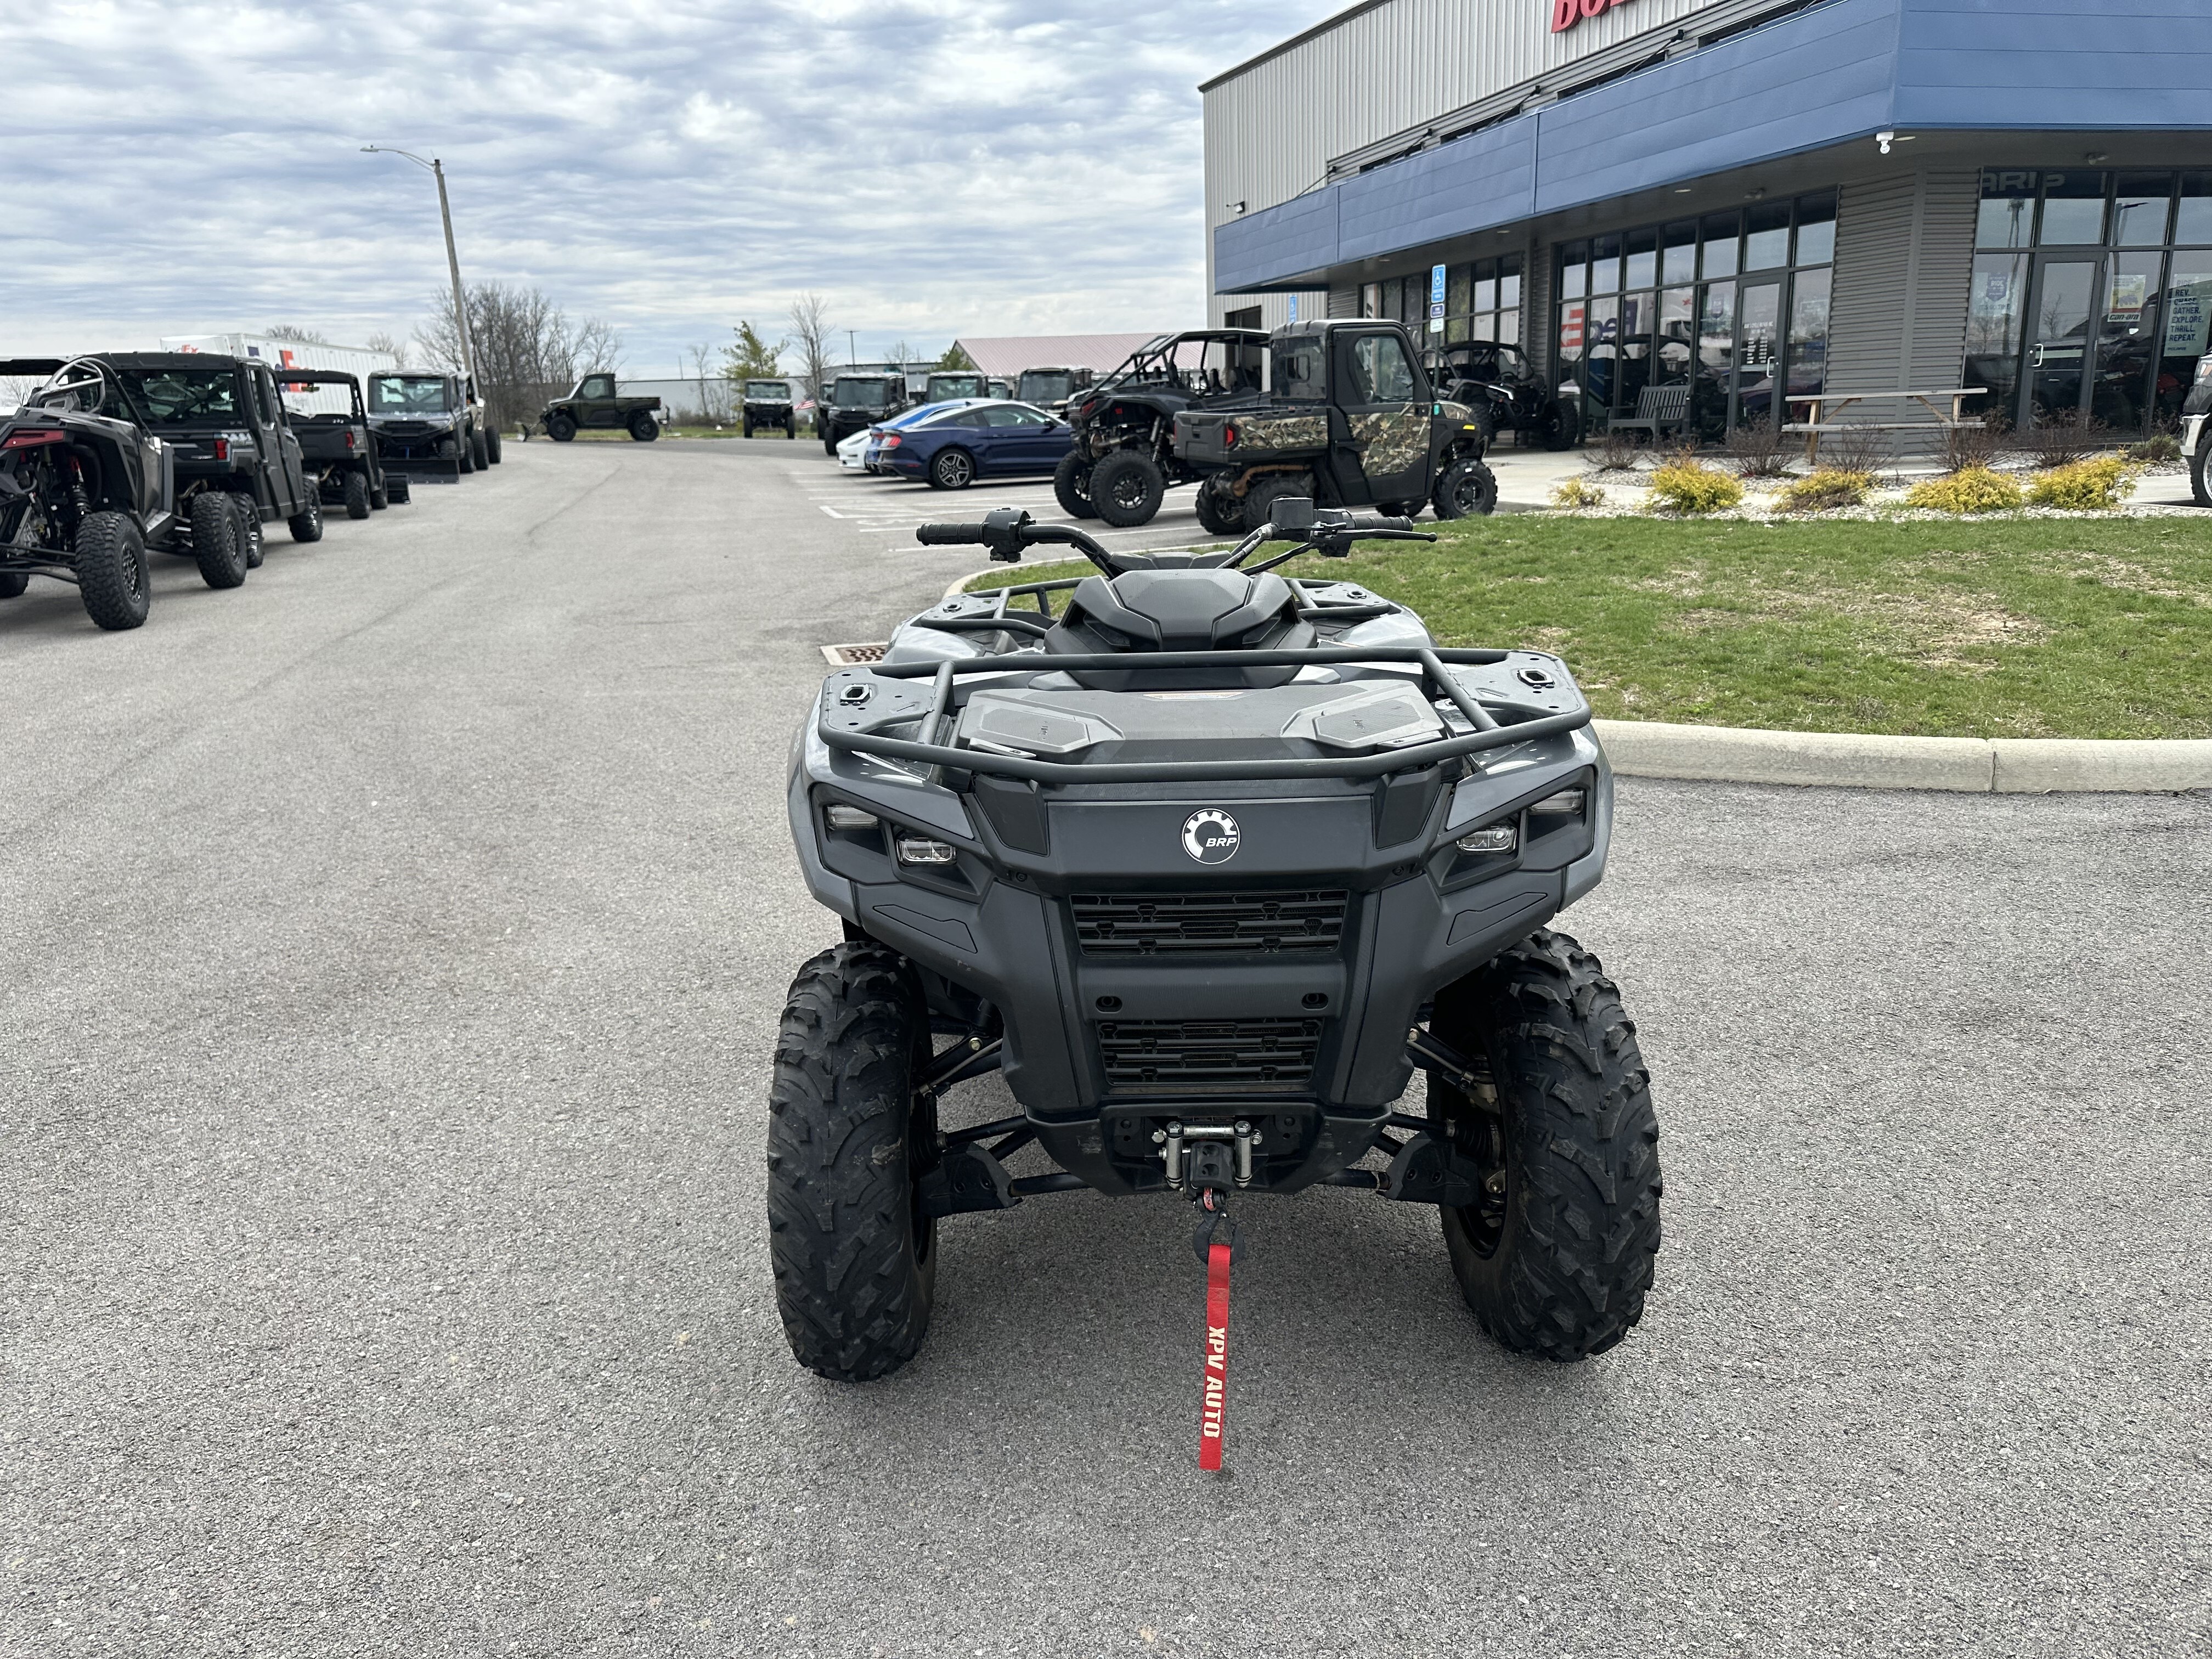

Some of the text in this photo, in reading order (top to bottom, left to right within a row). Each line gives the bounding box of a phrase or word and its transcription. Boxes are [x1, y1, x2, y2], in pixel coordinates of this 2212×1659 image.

[2171, 315, 2204, 324] EXPLORE.
[1205, 837, 1237, 847] BRP
[1203, 1325, 1226, 1438] XPV AUTO
